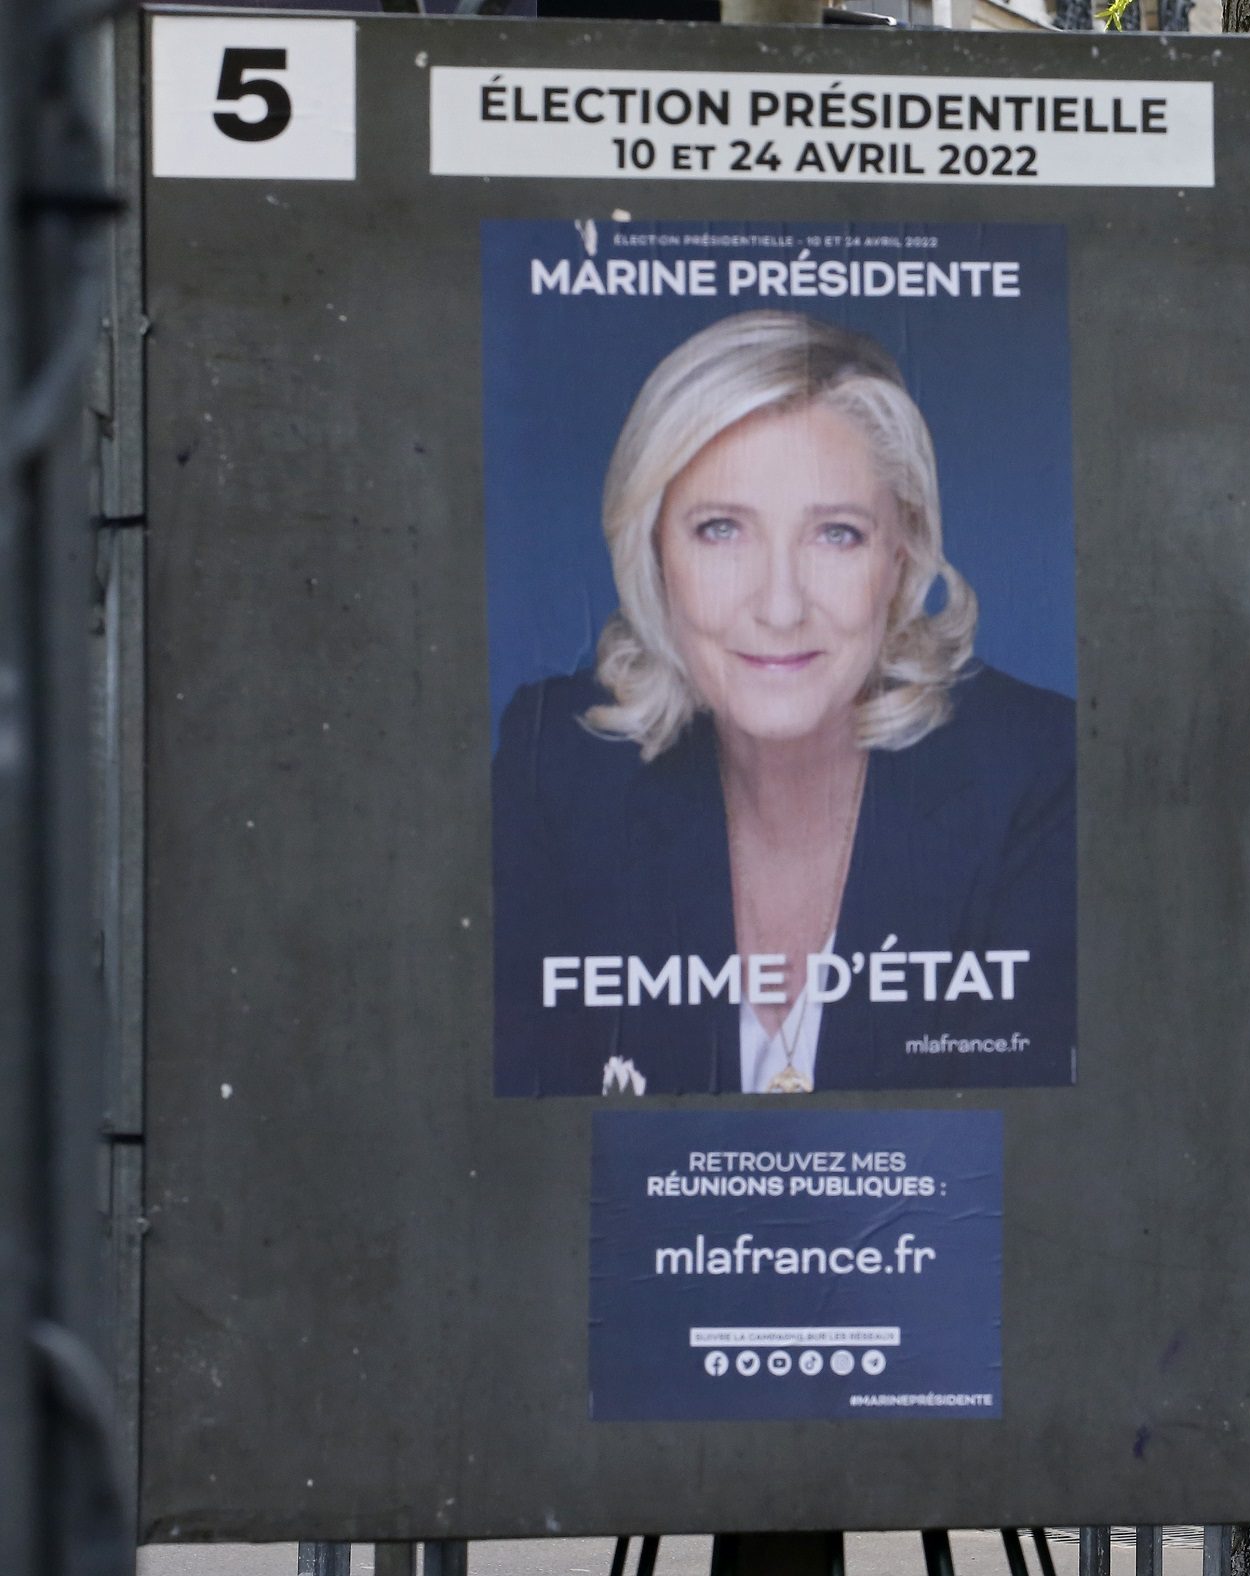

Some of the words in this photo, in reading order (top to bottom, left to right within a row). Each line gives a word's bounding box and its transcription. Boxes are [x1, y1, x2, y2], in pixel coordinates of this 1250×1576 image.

[212, 47, 292, 142] 5
[481, 74, 730, 125] ÉLECTION
[750, 81, 1168, 134] PRÉSIDENTIELLE
[612, 139, 655, 170] 10
[673, 145, 716, 170] ET
[730, 141, 781, 172] 24
[796, 143, 924, 174] AVRIL
[938, 144, 1038, 177] 2022
[824, 235, 841, 247] ET
[531, 259, 717, 295] MARINE
[729, 249, 1021, 297] PRÉSIDENTE
[542, 954, 786, 1008] FEMME
[807, 934, 1030, 1003] D’ÉTAT
[905, 1032, 1031, 1054] mlafrance.fr
[689, 1151, 845, 1173] RETROUVEZ
[851, 1151, 906, 1173] MES
[647, 1170, 784, 1197] RÉUNIONS
[790, 1175, 935, 1199] PUBLIQUES
[655, 1234, 936, 1275] mlafrance.fr
[849, 1391, 993, 1407] #MARINEPRÉSIDENTE
